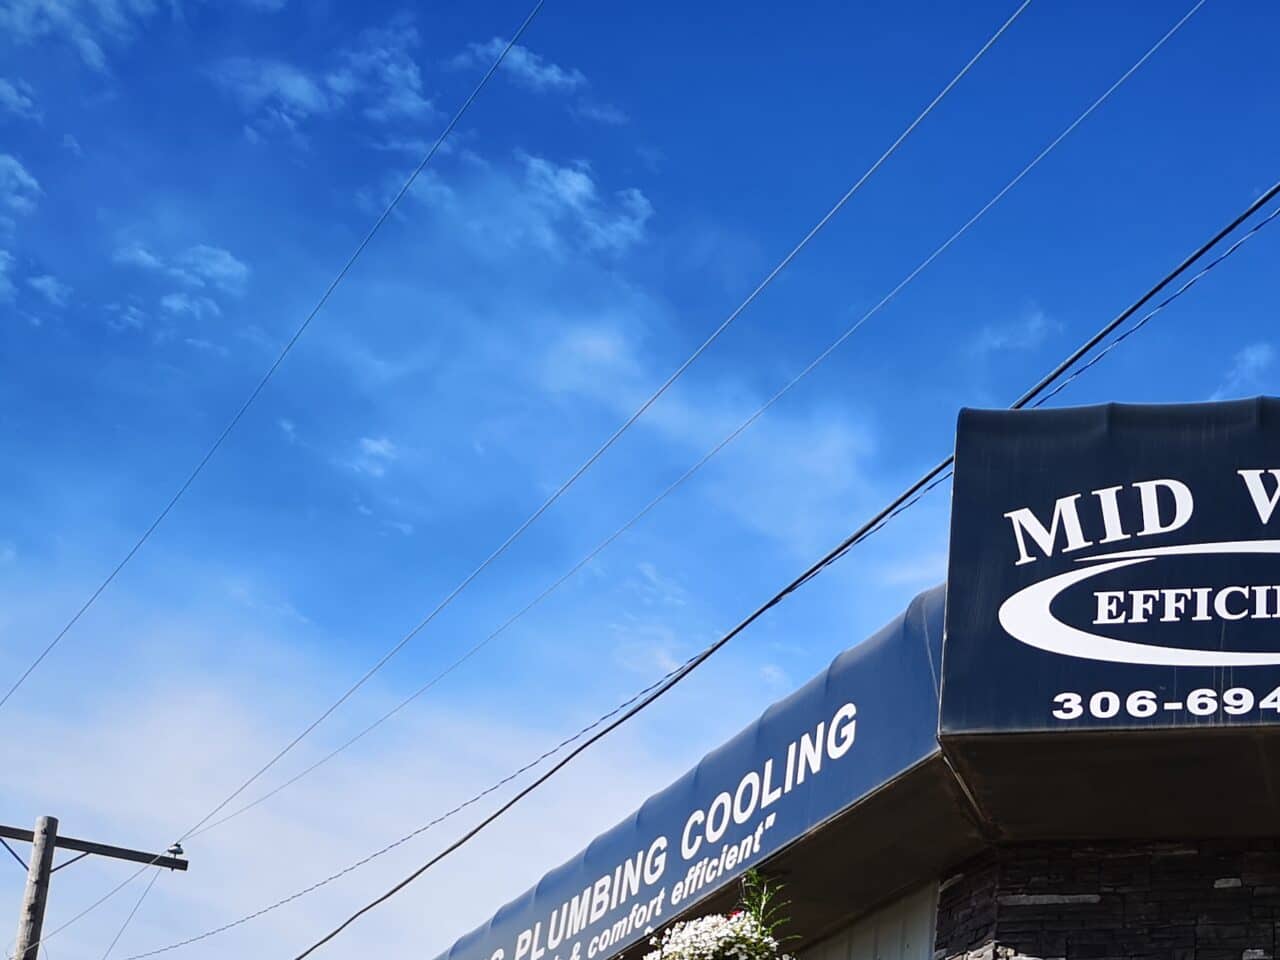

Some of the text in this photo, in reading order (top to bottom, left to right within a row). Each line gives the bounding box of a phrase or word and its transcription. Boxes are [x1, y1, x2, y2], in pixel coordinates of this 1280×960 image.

[1004, 478, 1194, 566] MID
[681, 702, 857, 860] COOLING
[588, 894, 664, 958] comfort
[671, 813, 776, 906] efficient"
